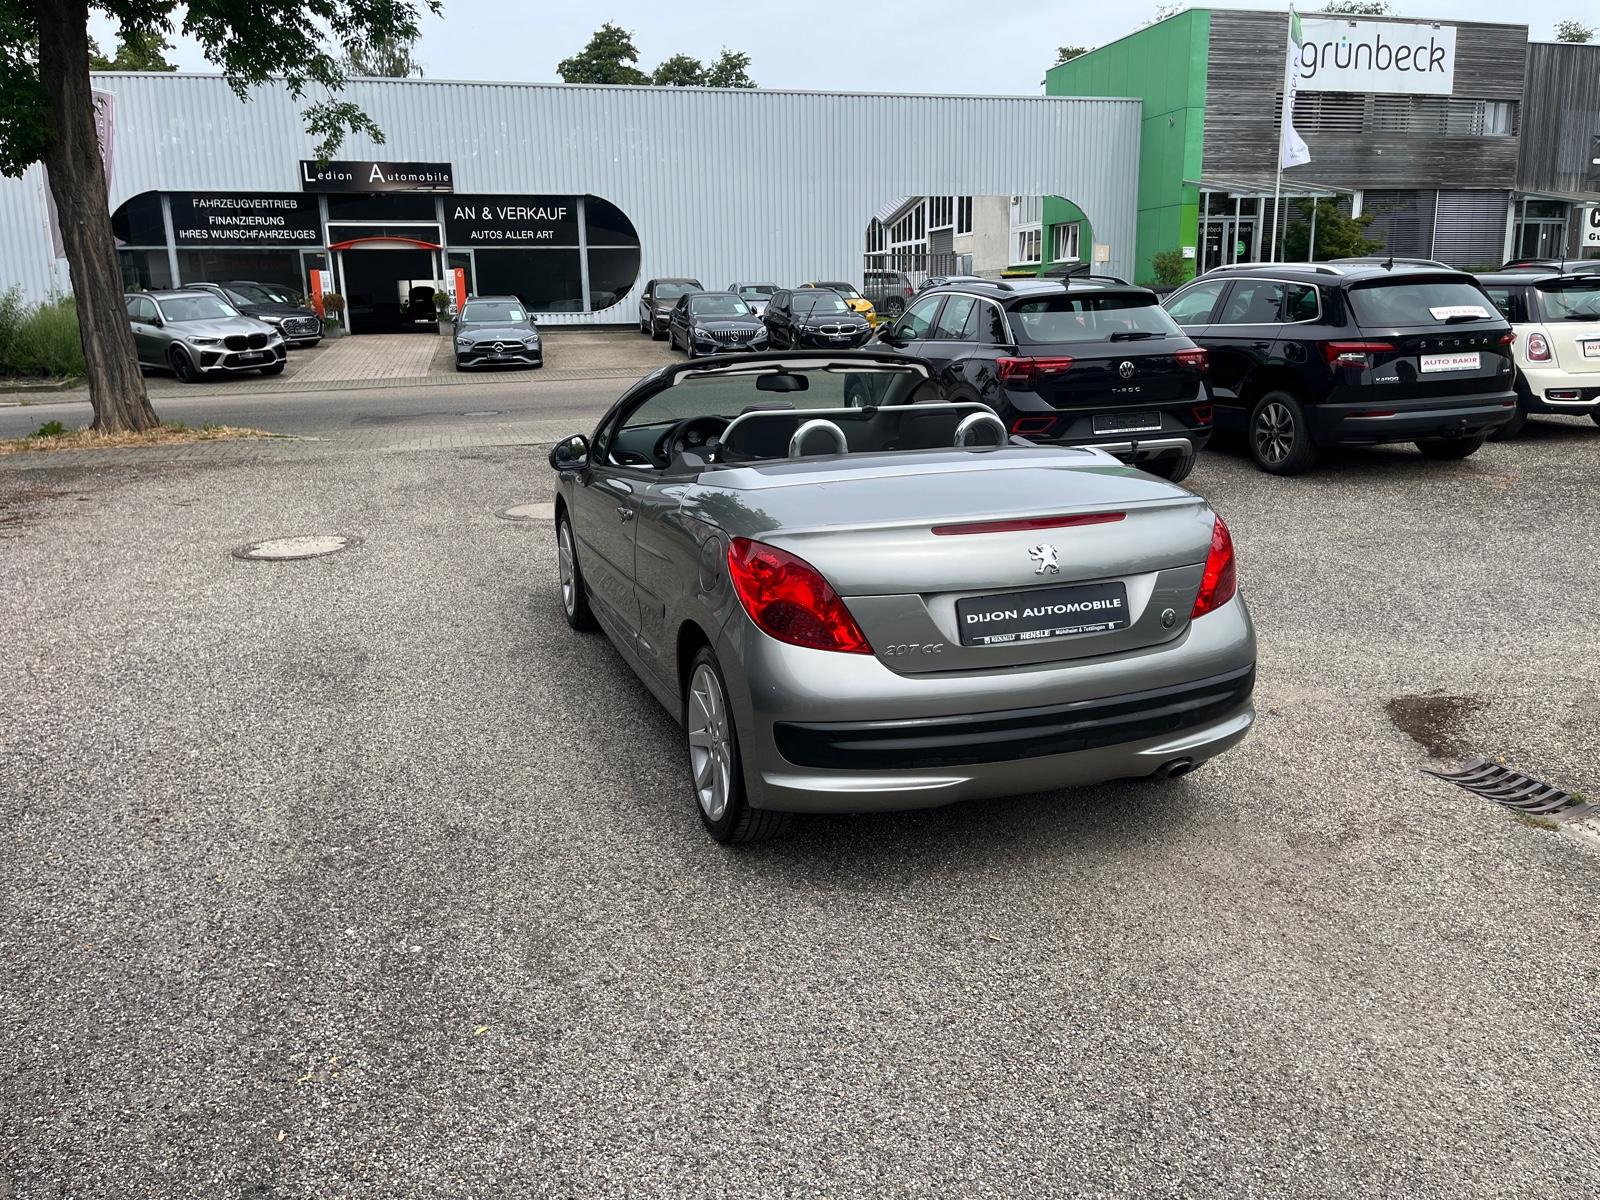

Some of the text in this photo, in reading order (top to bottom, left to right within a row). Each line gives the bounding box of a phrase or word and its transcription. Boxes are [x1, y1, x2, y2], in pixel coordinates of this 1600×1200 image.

[1300, 33, 1446, 79] grünbeck
[303, 162, 449, 183] Ledion Automobile
[192, 198, 298, 209] FAHRZEUGVERTRIEB
[454, 206, 567, 220] AN & VERKAUF
[208, 215, 285, 226] FINANZIERUNG
[179, 229, 316, 240] IHRES WUNSCHFAHRZEUGES
[470, 230, 554, 239] AUTOS ALLER ART
[966, 598, 1122, 624] DIJON AUTOMOBILE
[1020, 630, 1050, 640] HENSLE
[883, 643, 944, 656] 207 CC
